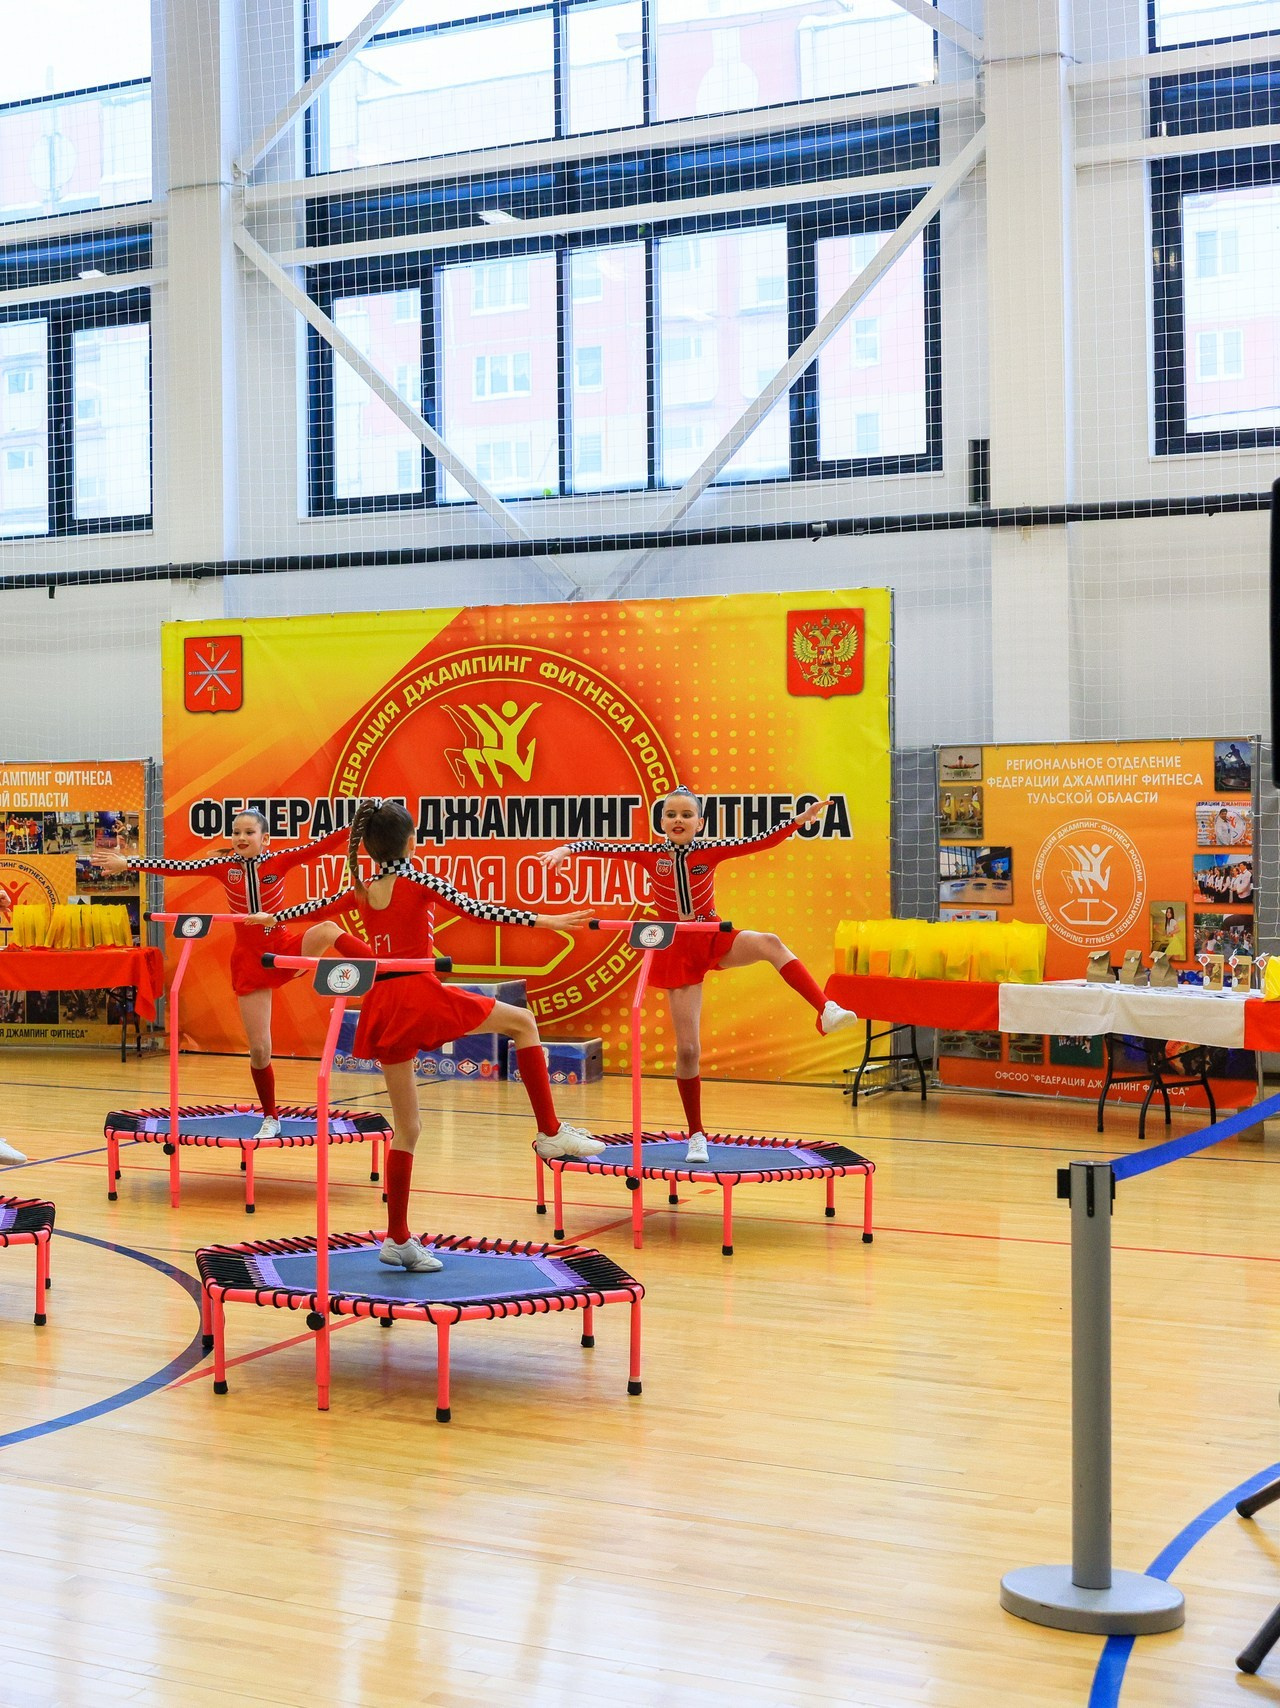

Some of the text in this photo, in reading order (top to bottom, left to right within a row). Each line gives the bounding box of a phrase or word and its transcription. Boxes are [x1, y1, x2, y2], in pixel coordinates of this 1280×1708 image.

[338, 700, 401, 798] ДЕРАЦИЯ
[402, 655, 533, 707] ДЖАМПИНГ
[539, 662, 636, 733] ФИТНЕСА
[1006, 756, 1181, 771] РЕГИОНАЛЬНОЕ ОТДЕЛЕНИЕ
[55, 770, 113, 786] ФИТНЕСА
[986, 773, 1203, 789] ФЕДЕРАЦИИ ДЖАМПИНГ ФИТНЕСА
[13, 792, 69, 808] ОБЛАСТИ
[1027, 789, 1158, 804] ТУЛЬСКОЙ ОБЛАСТИ
[416, 796, 642, 846] ДЖАМПИНГ
[1035, 836, 1057, 880] ФЕДЕРАЦИЯ
[1129, 849, 1143, 882] РОССИИ
[18, 864, 46, 885] ФИТНЕСА
[516, 855, 656, 907] ОБЛАС
[1036, 889, 1143, 944] RUSSIAN JUMPING FITNESS FEDERATION
[374, 934, 391, 955] F1
[5, 1028, 48, 1039] ДЖАМПИНГ
[995, 1071, 1029, 1082] ОФСОО
[1031, 1073, 1085, 1087] "ФЕДЕРАЦИЯ
[1087, 1079, 1140, 1092] ДЖМПИНГ
